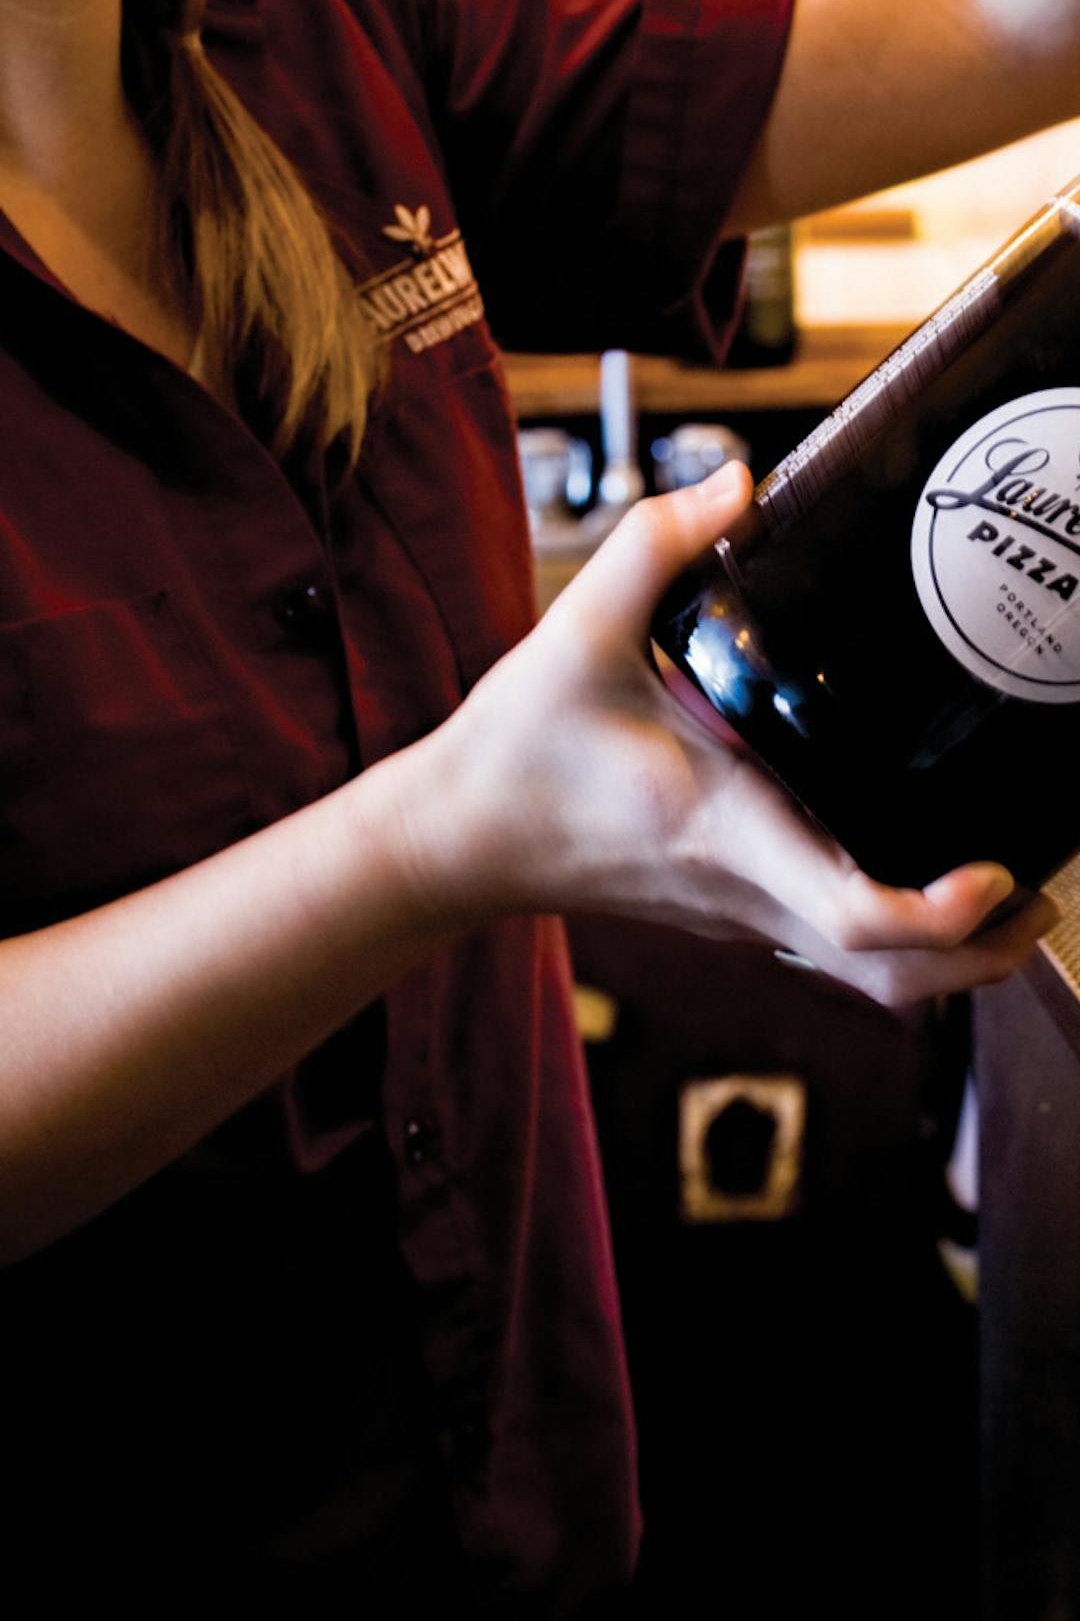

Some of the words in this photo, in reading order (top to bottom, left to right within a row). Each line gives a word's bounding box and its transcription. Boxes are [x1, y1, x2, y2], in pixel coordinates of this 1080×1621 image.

[967, 520, 1079, 602] PIZZA
[996, 602, 1044, 656] OREGON
[999, 583, 1062, 654] PORTLAND
